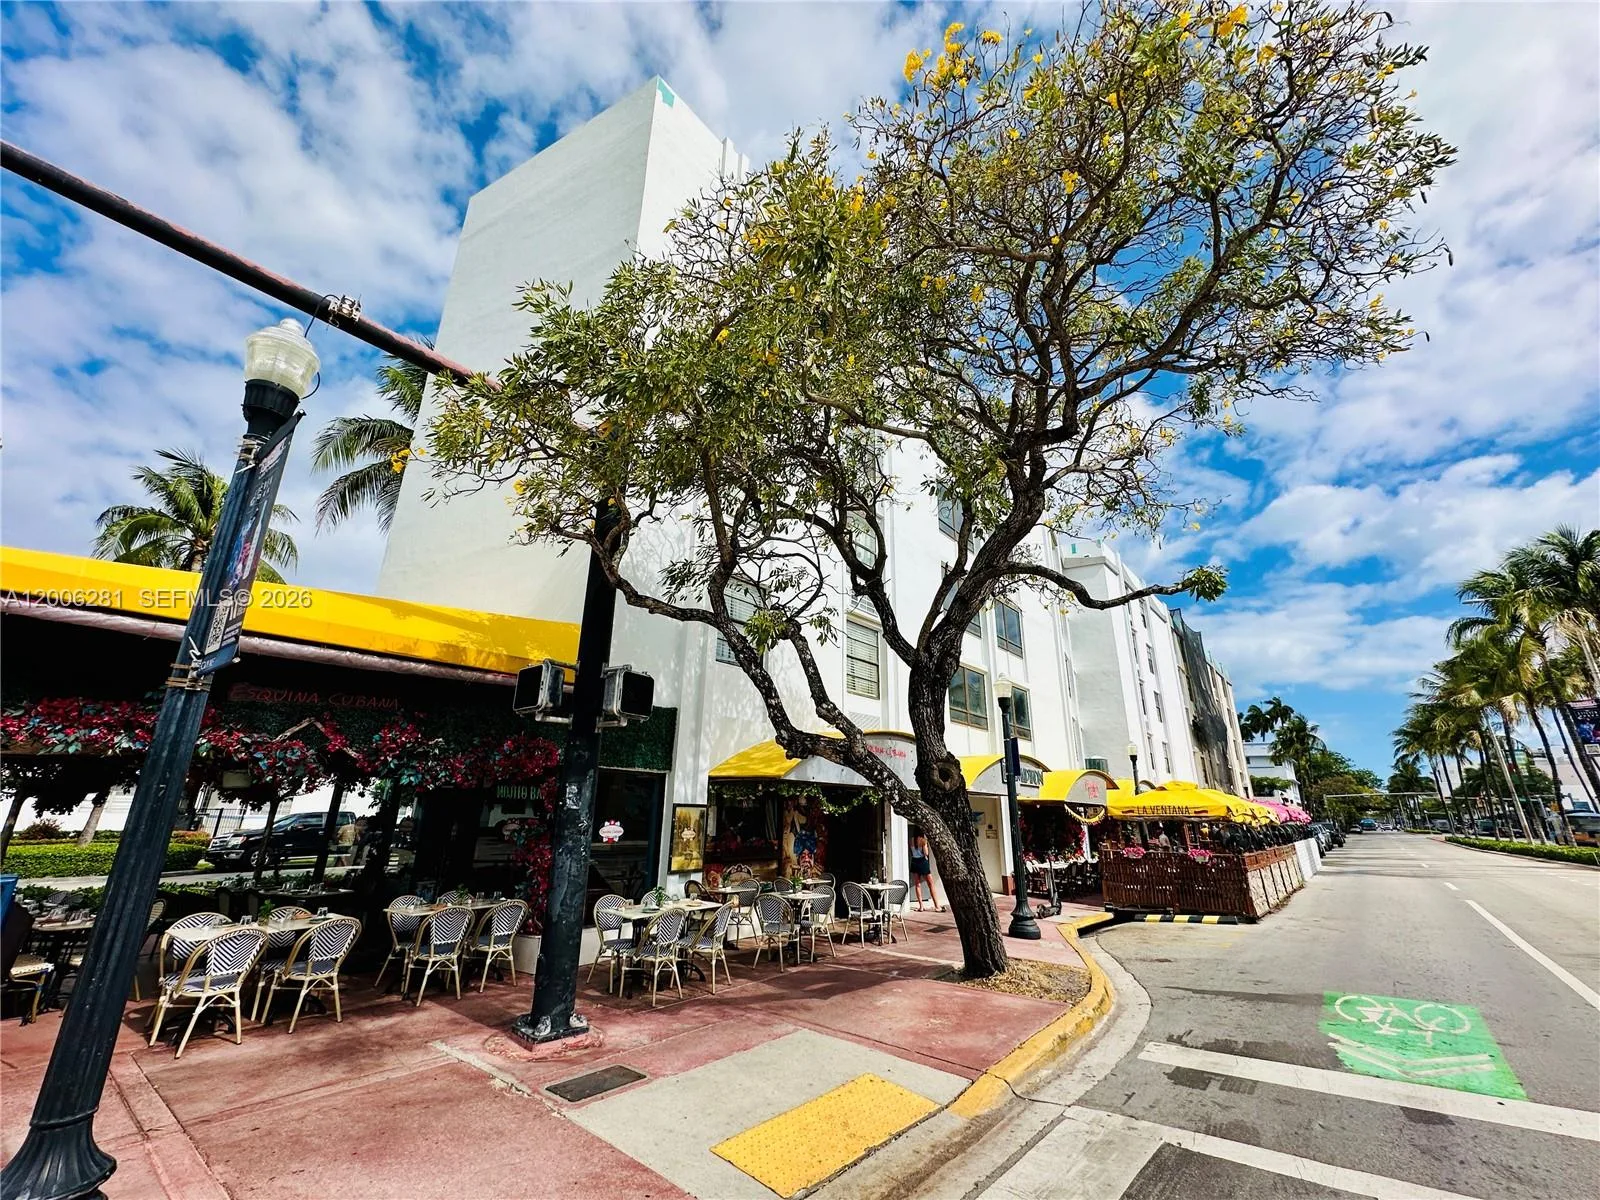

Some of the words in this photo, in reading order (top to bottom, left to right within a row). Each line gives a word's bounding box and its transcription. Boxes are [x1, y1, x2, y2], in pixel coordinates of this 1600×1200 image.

[230, 683, 319, 705] ESQUINA
[328, 693, 399, 710] CUBANA
[496, 785, 528, 800] MOJITO
[1136, 807, 1148, 815] LA
[1150, 806, 1190, 815] VENTANA
